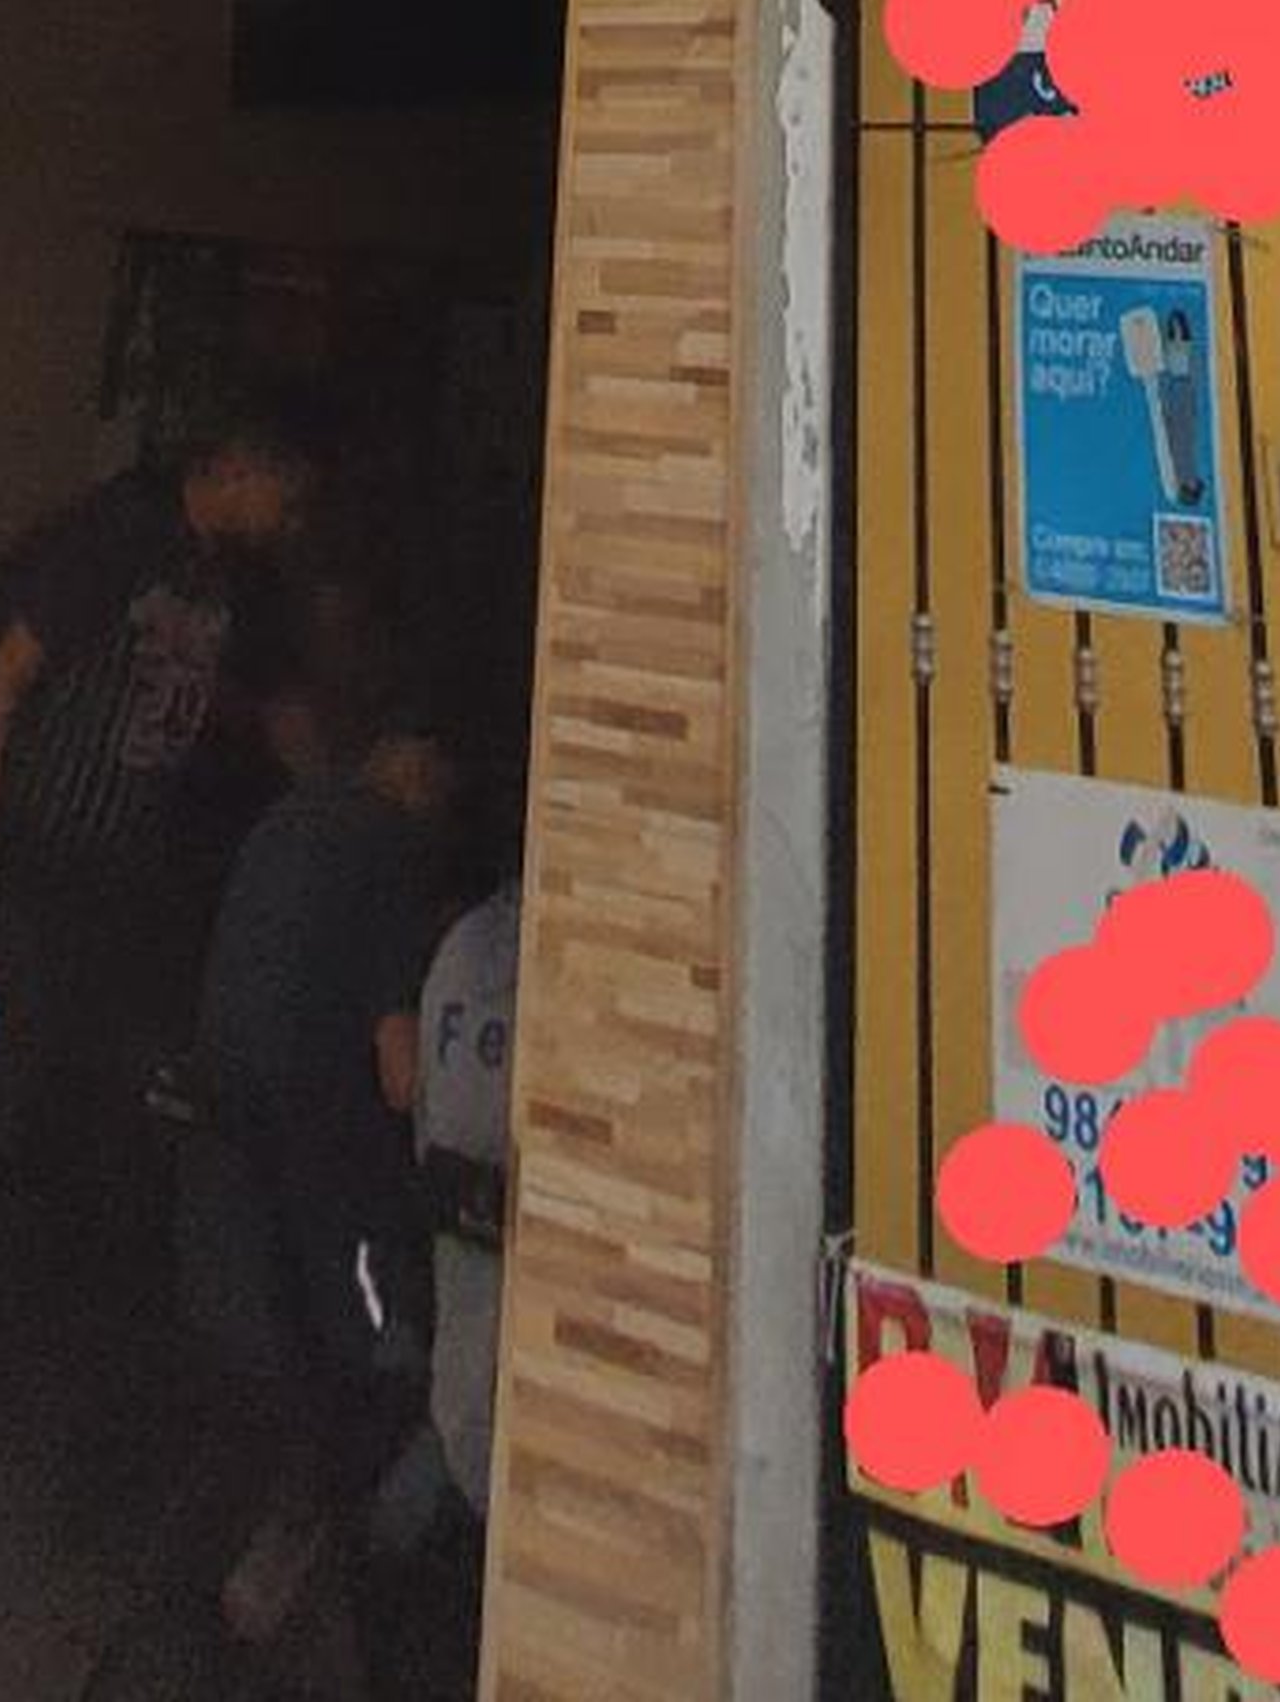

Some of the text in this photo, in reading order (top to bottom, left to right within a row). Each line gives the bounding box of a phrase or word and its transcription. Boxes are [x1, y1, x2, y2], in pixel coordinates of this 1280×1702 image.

[1028, 282, 1103, 321] Quer
[1028, 327, 1118, 359] morar
[1031, 359, 1111, 402] aqui?
